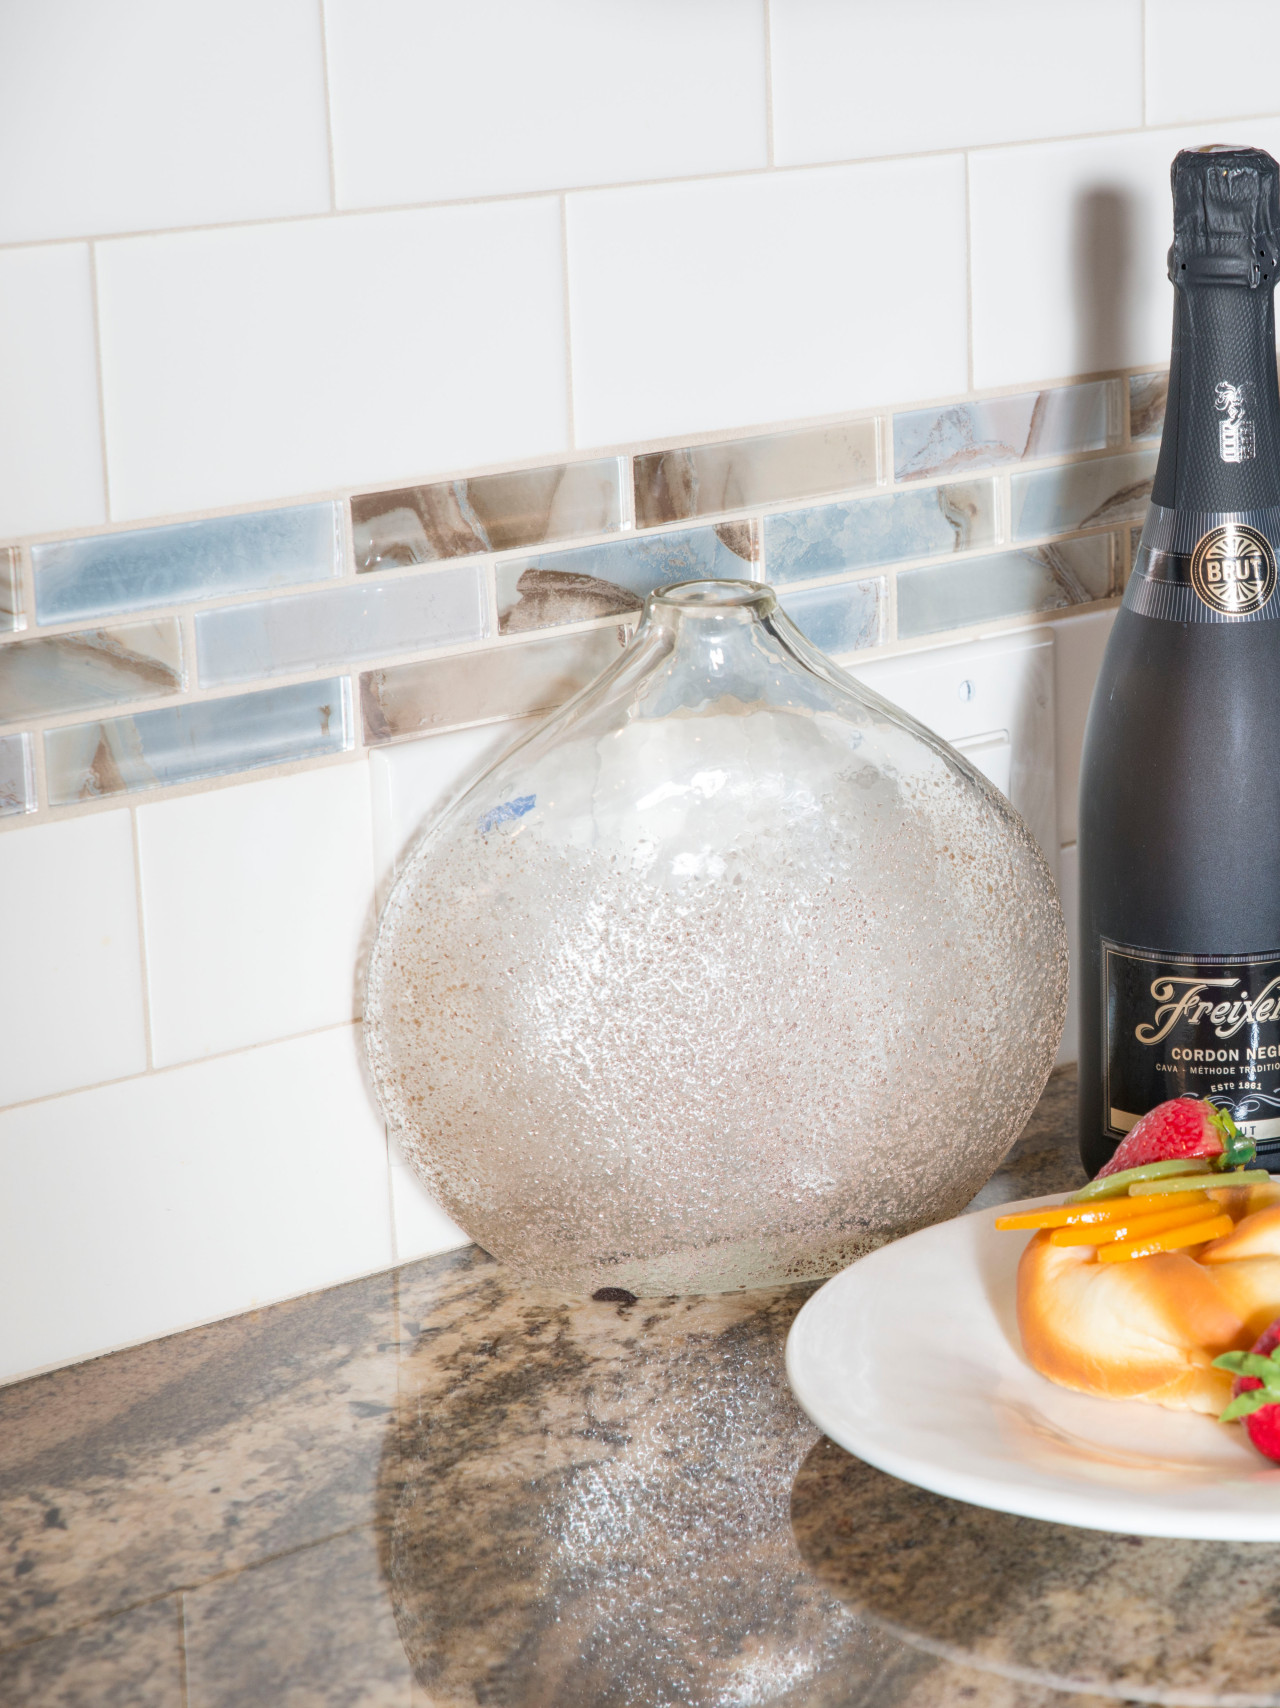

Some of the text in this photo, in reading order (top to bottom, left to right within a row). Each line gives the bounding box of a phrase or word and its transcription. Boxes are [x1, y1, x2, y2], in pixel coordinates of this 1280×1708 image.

[1207, 558, 1261, 582] BRUT
[1171, 1047, 1239, 1062] CORDON
[1155, 1063, 1179, 1073] CAVA
[1189, 1065, 1236, 1075] MÉTHODE
[1238, 1081, 1262, 1091] 1861
